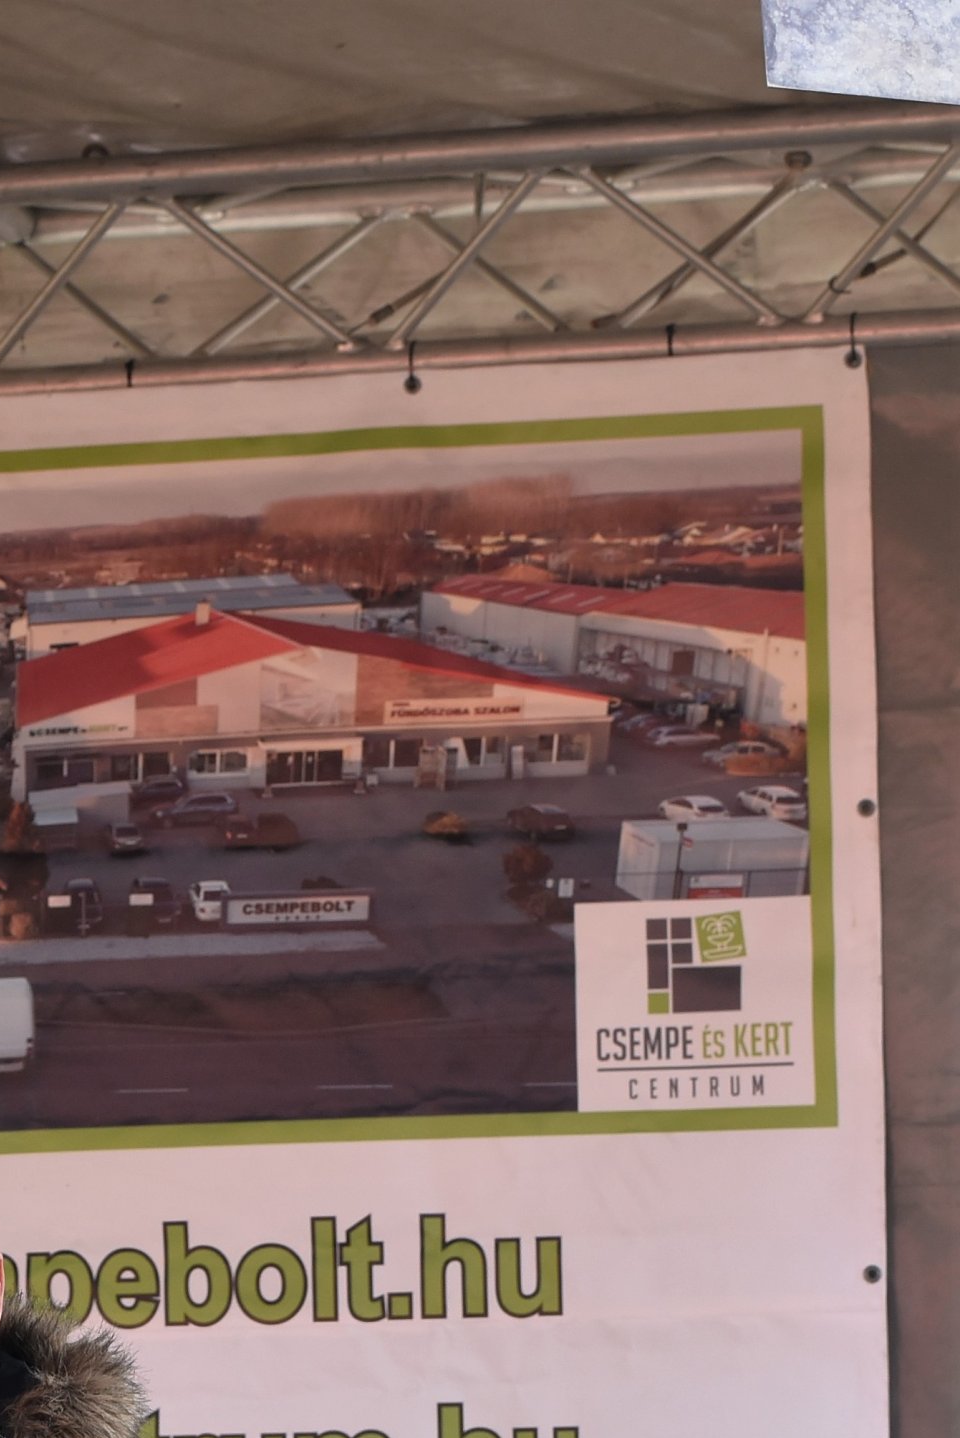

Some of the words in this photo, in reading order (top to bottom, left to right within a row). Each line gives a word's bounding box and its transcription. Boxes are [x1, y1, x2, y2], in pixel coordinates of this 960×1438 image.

[242, 900, 355, 915] CSEMPEBOLT
[596, 1026, 694, 1062] CSEMPE
[734, 1022, 793, 1058] KERT
[629, 1075, 765, 1100] CENTRUM
